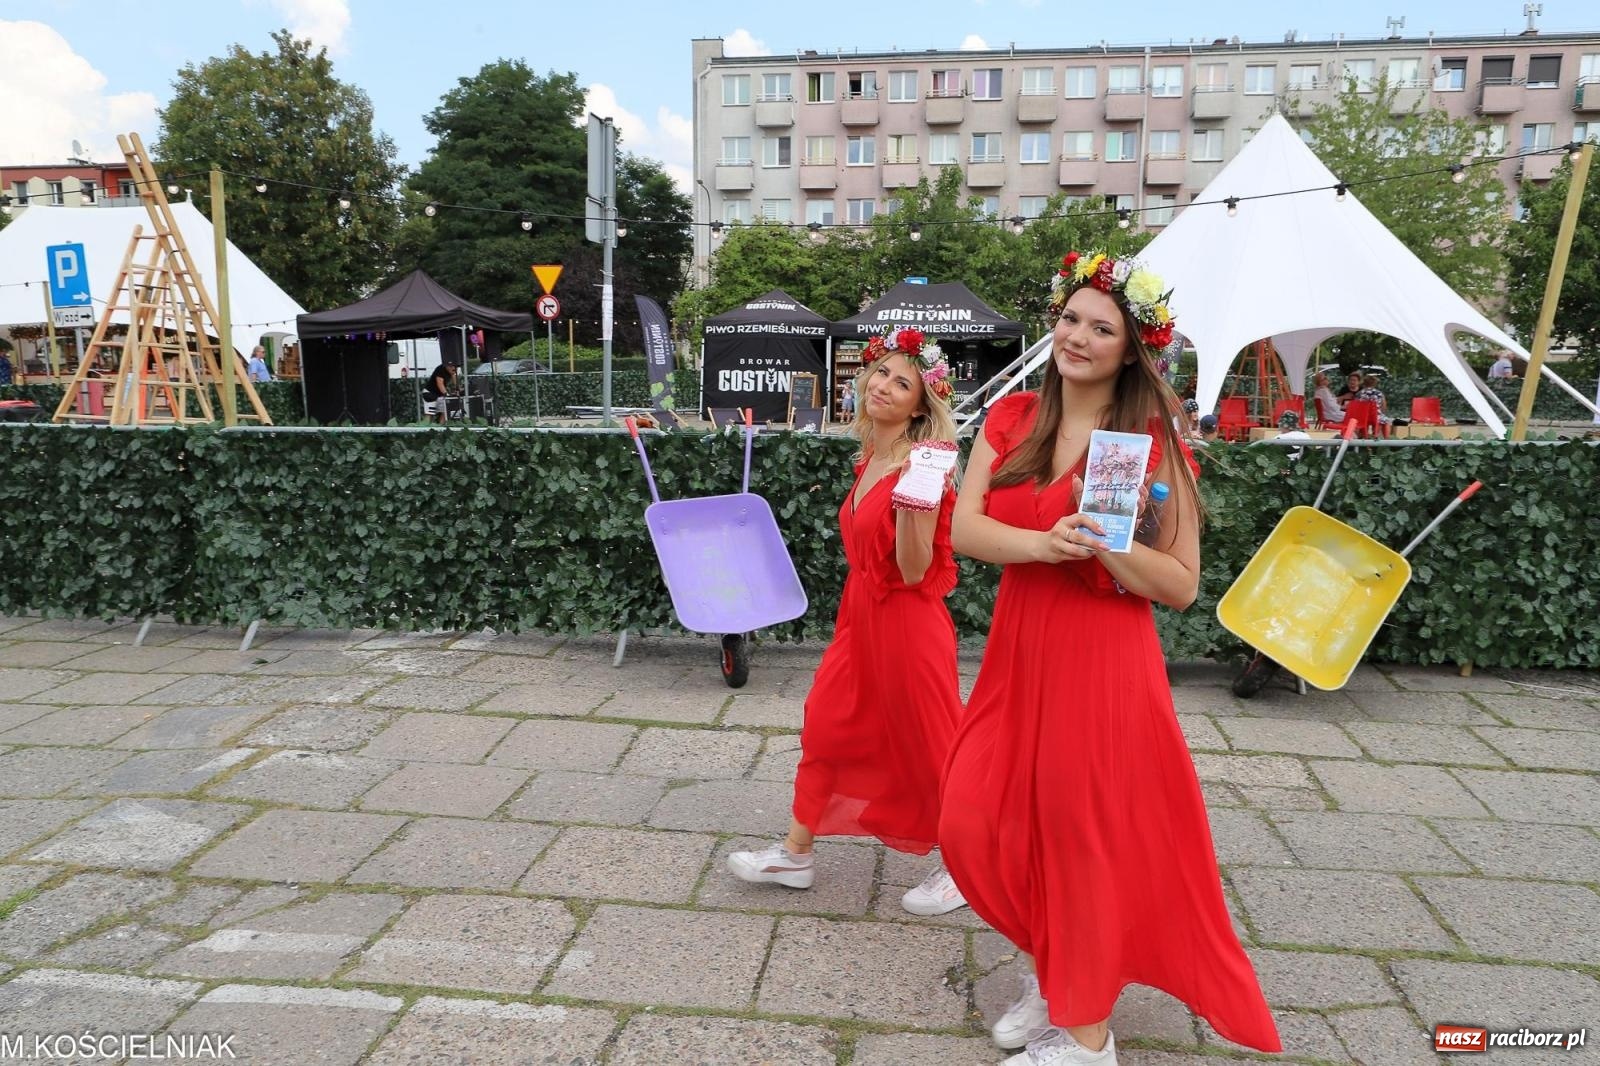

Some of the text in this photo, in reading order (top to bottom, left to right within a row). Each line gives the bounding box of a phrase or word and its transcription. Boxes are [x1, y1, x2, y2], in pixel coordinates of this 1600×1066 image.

[55, 250, 78, 288] P
[745, 302, 797, 311] GOSTYNIN
[54, 311, 79, 325] Wjazd
[876, 308, 973, 321] GOSTYNIN
[705, 323, 826, 336] PIWO RZEMIEŚLNICZE
[739, 358, 791, 366] BROWAR
[718, 367, 811, 393] GOSTYN
